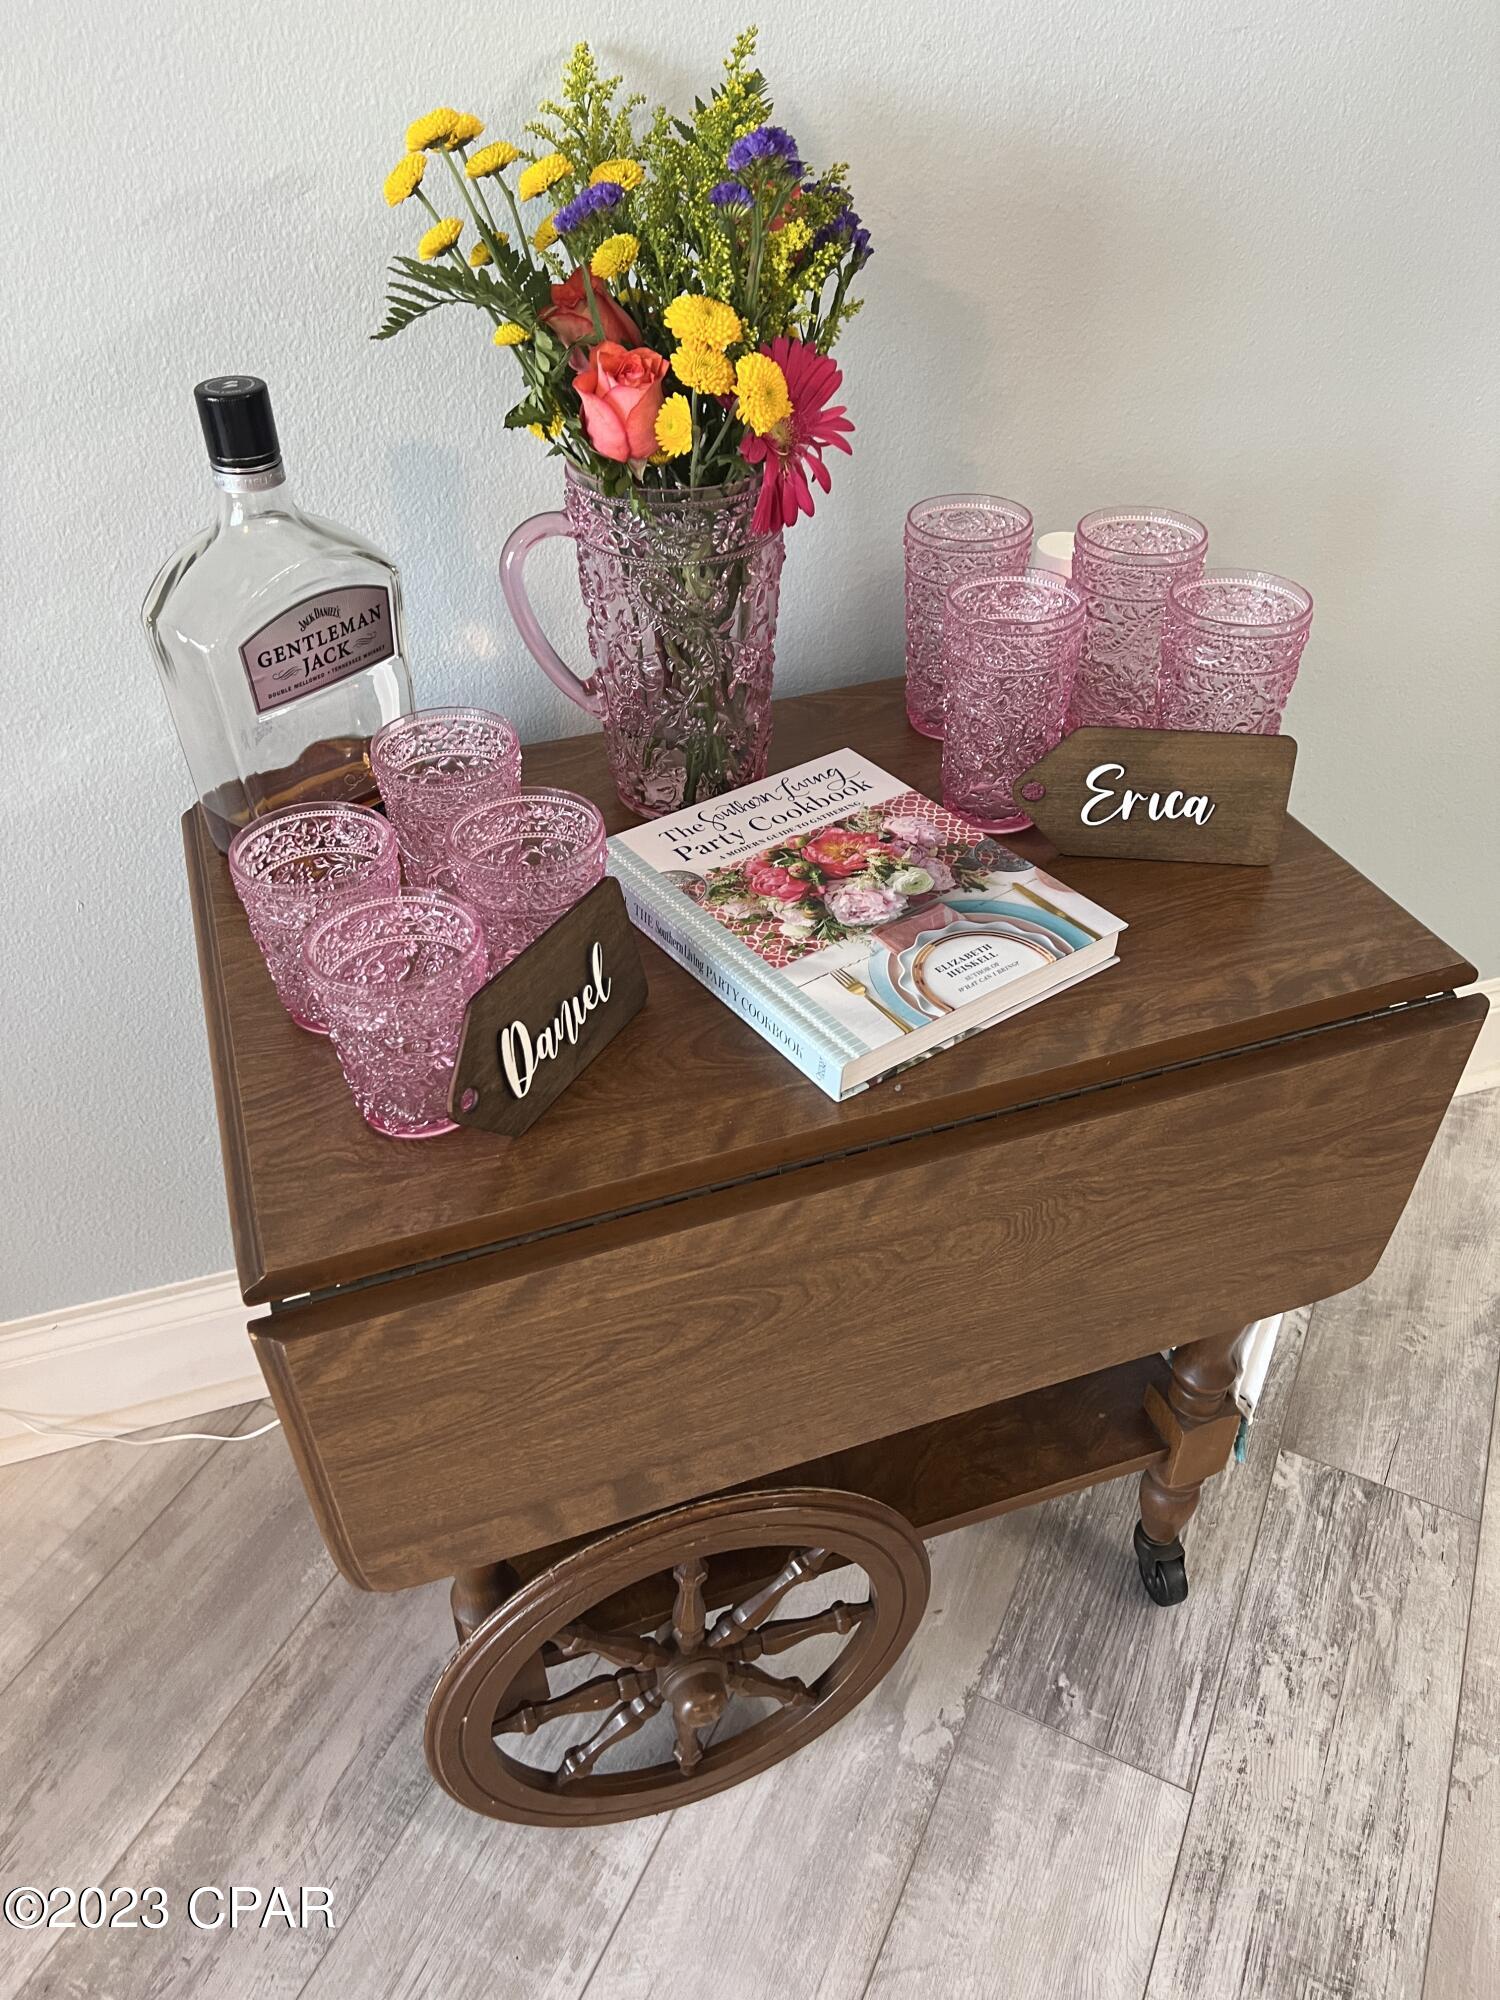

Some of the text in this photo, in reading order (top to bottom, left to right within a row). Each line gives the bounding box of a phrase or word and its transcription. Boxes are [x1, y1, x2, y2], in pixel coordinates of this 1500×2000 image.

[257, 604, 382, 668] GENTLEMAN
[298, 613, 315, 632] JACK
[268, 686, 292, 699] DOUBLE
[294, 672, 325, 689] MELLOWED
[331, 656, 361, 673] TENNESSEE
[303, 640, 353, 676] JACK
[658, 768, 861, 844] The Southern Living
[673, 779, 873, 864] Party Cookbook
[1080, 763, 1216, 827] Erica
[725, 838, 765, 859] MODERN
[766, 828, 796, 841] GUIDE
[796, 821, 809, 830] TO
[809, 801, 861, 824] GATHERING
[633, 902, 803, 1059] THE Southern Living PARTY COOKBOOK
[934, 943, 993, 974] ELIZABETH
[946, 952, 999, 978] HEISKELL
[501, 941, 611, 1098] Daniel
